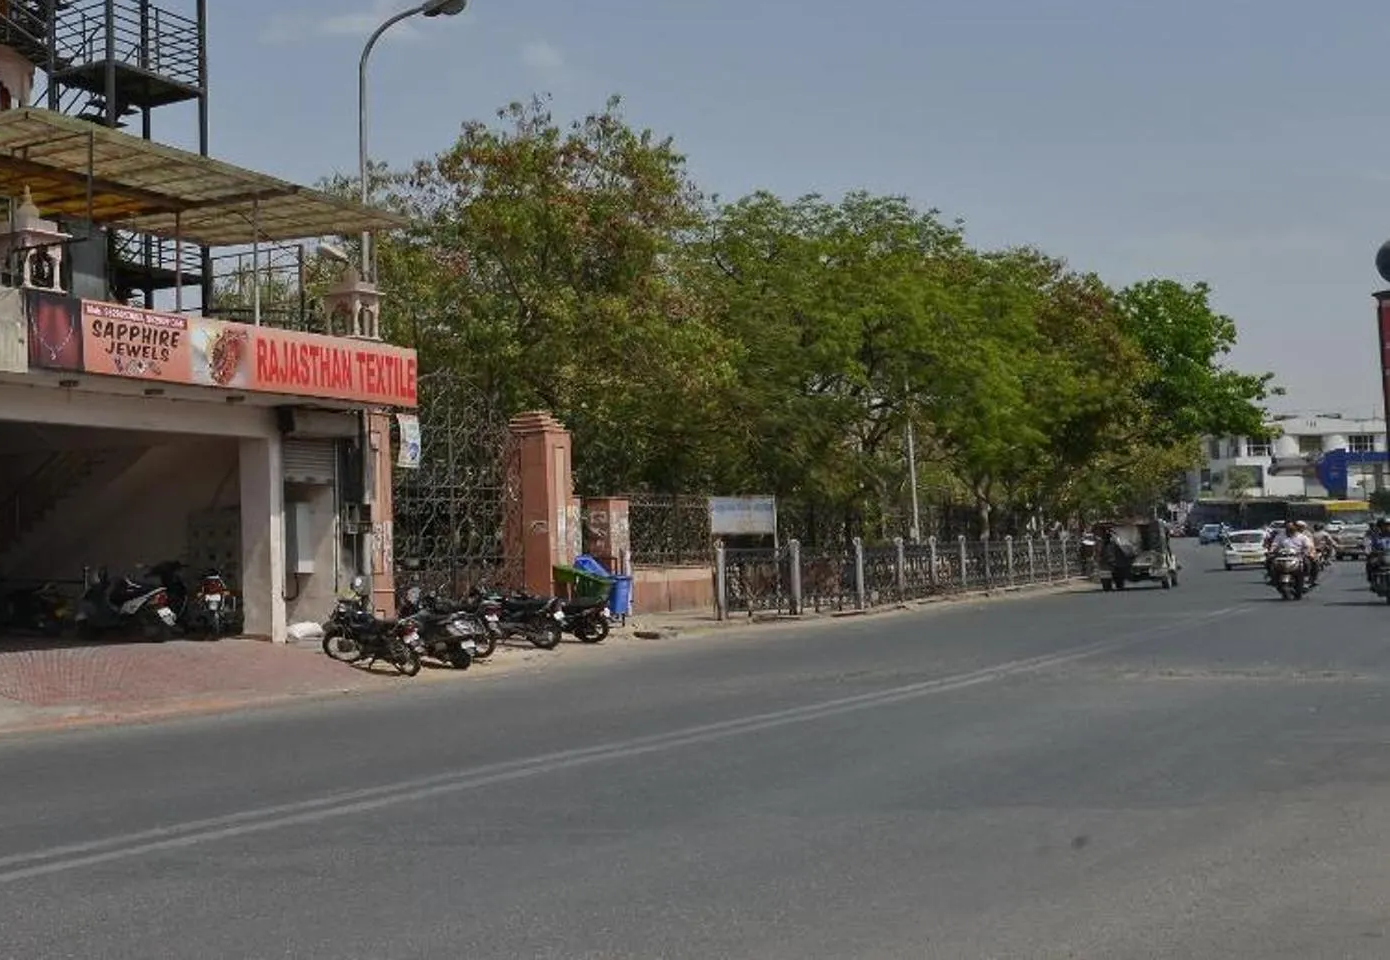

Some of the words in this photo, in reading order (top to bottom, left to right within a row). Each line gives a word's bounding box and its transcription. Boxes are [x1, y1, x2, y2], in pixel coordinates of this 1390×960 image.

[91, 319, 181, 348] SAPPHIRE
[104, 341, 170, 362] JEWELS
[256, 338, 353, 390] RAJASTHAN
[355, 350, 416, 400] TEXTILE
